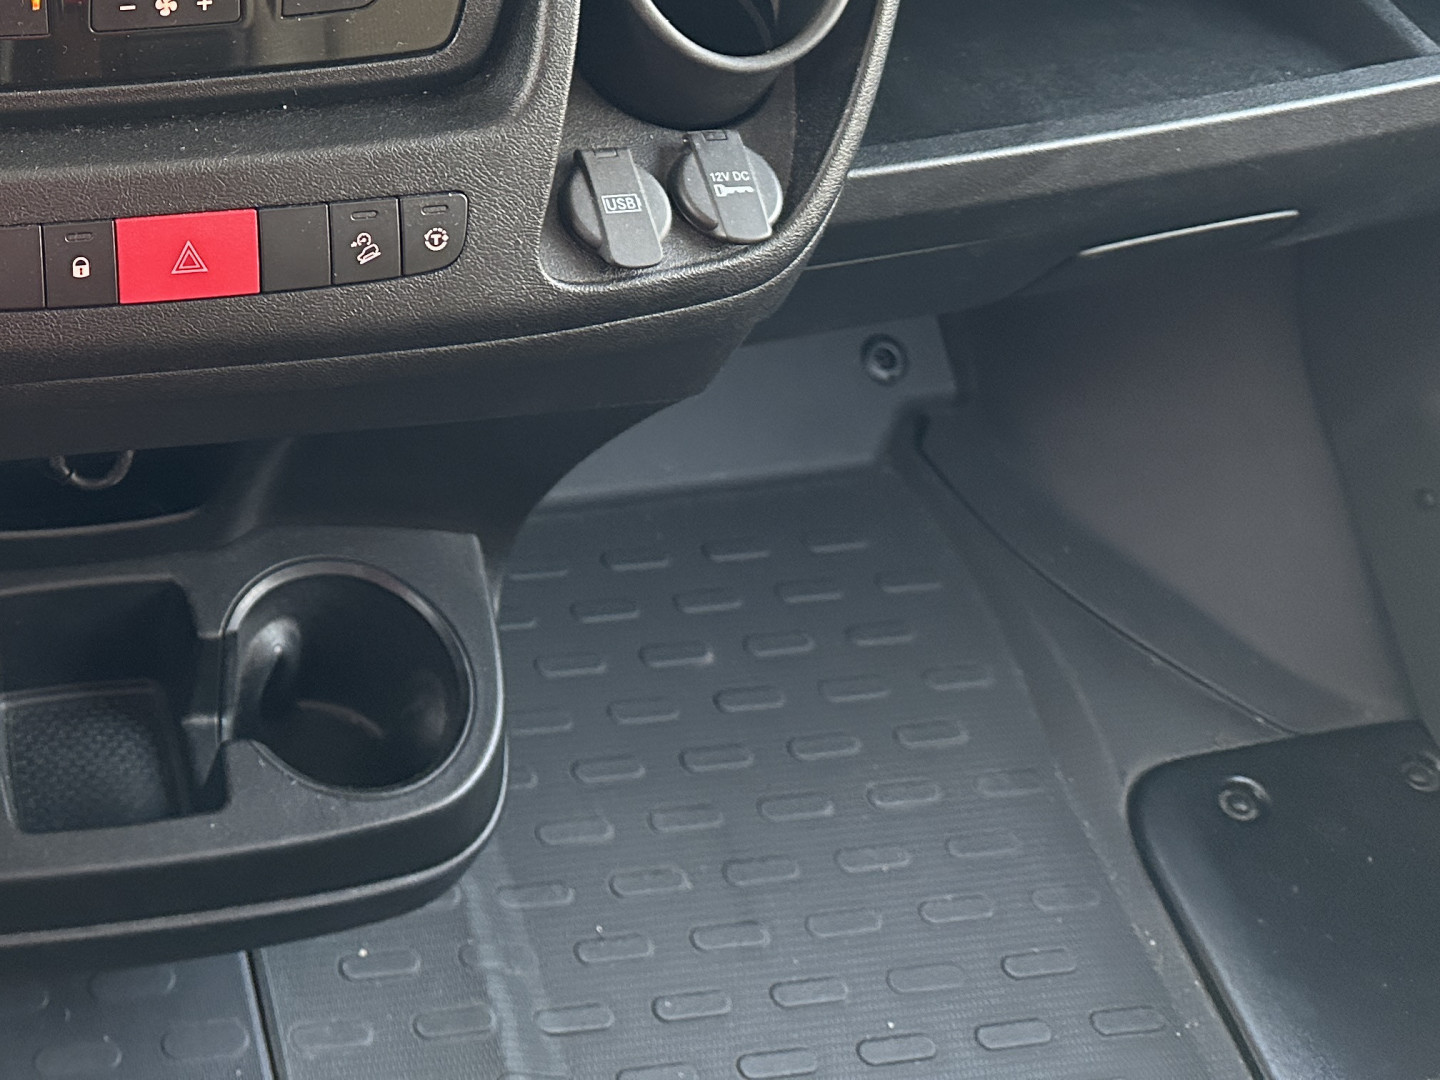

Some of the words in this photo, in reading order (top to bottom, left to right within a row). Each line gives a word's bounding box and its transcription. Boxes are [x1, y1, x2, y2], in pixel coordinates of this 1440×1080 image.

[710, 172, 729, 182] 12V
[733, 170, 750, 180] DC
[606, 198, 636, 211] USB
